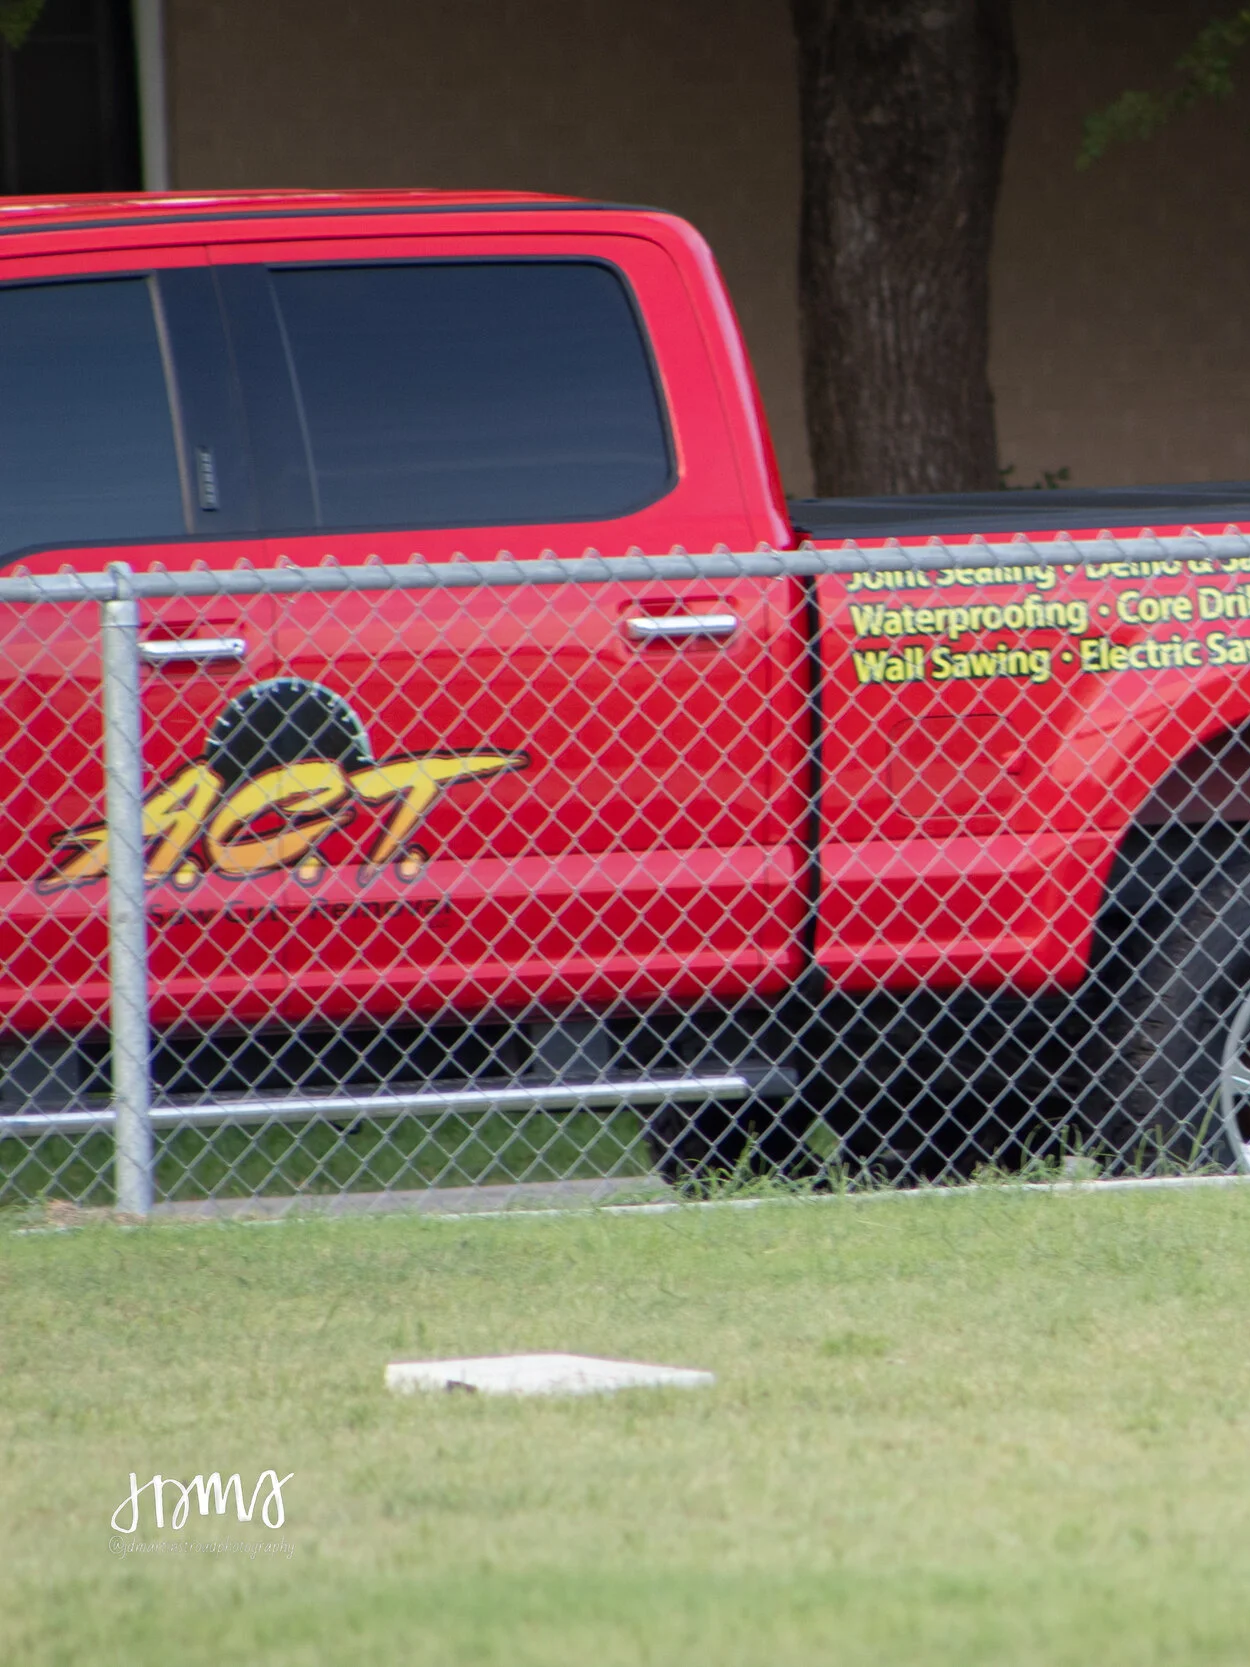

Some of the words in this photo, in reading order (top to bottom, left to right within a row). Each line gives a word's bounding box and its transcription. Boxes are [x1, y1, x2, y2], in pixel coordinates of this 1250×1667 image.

[848, 592, 1089, 641] Waterproofing
[1116, 589, 1194, 625] Core
[851, 643, 925, 684] Wall
[930, 642, 1052, 684] Sawing
[1079, 633, 1203, 674] Electric
